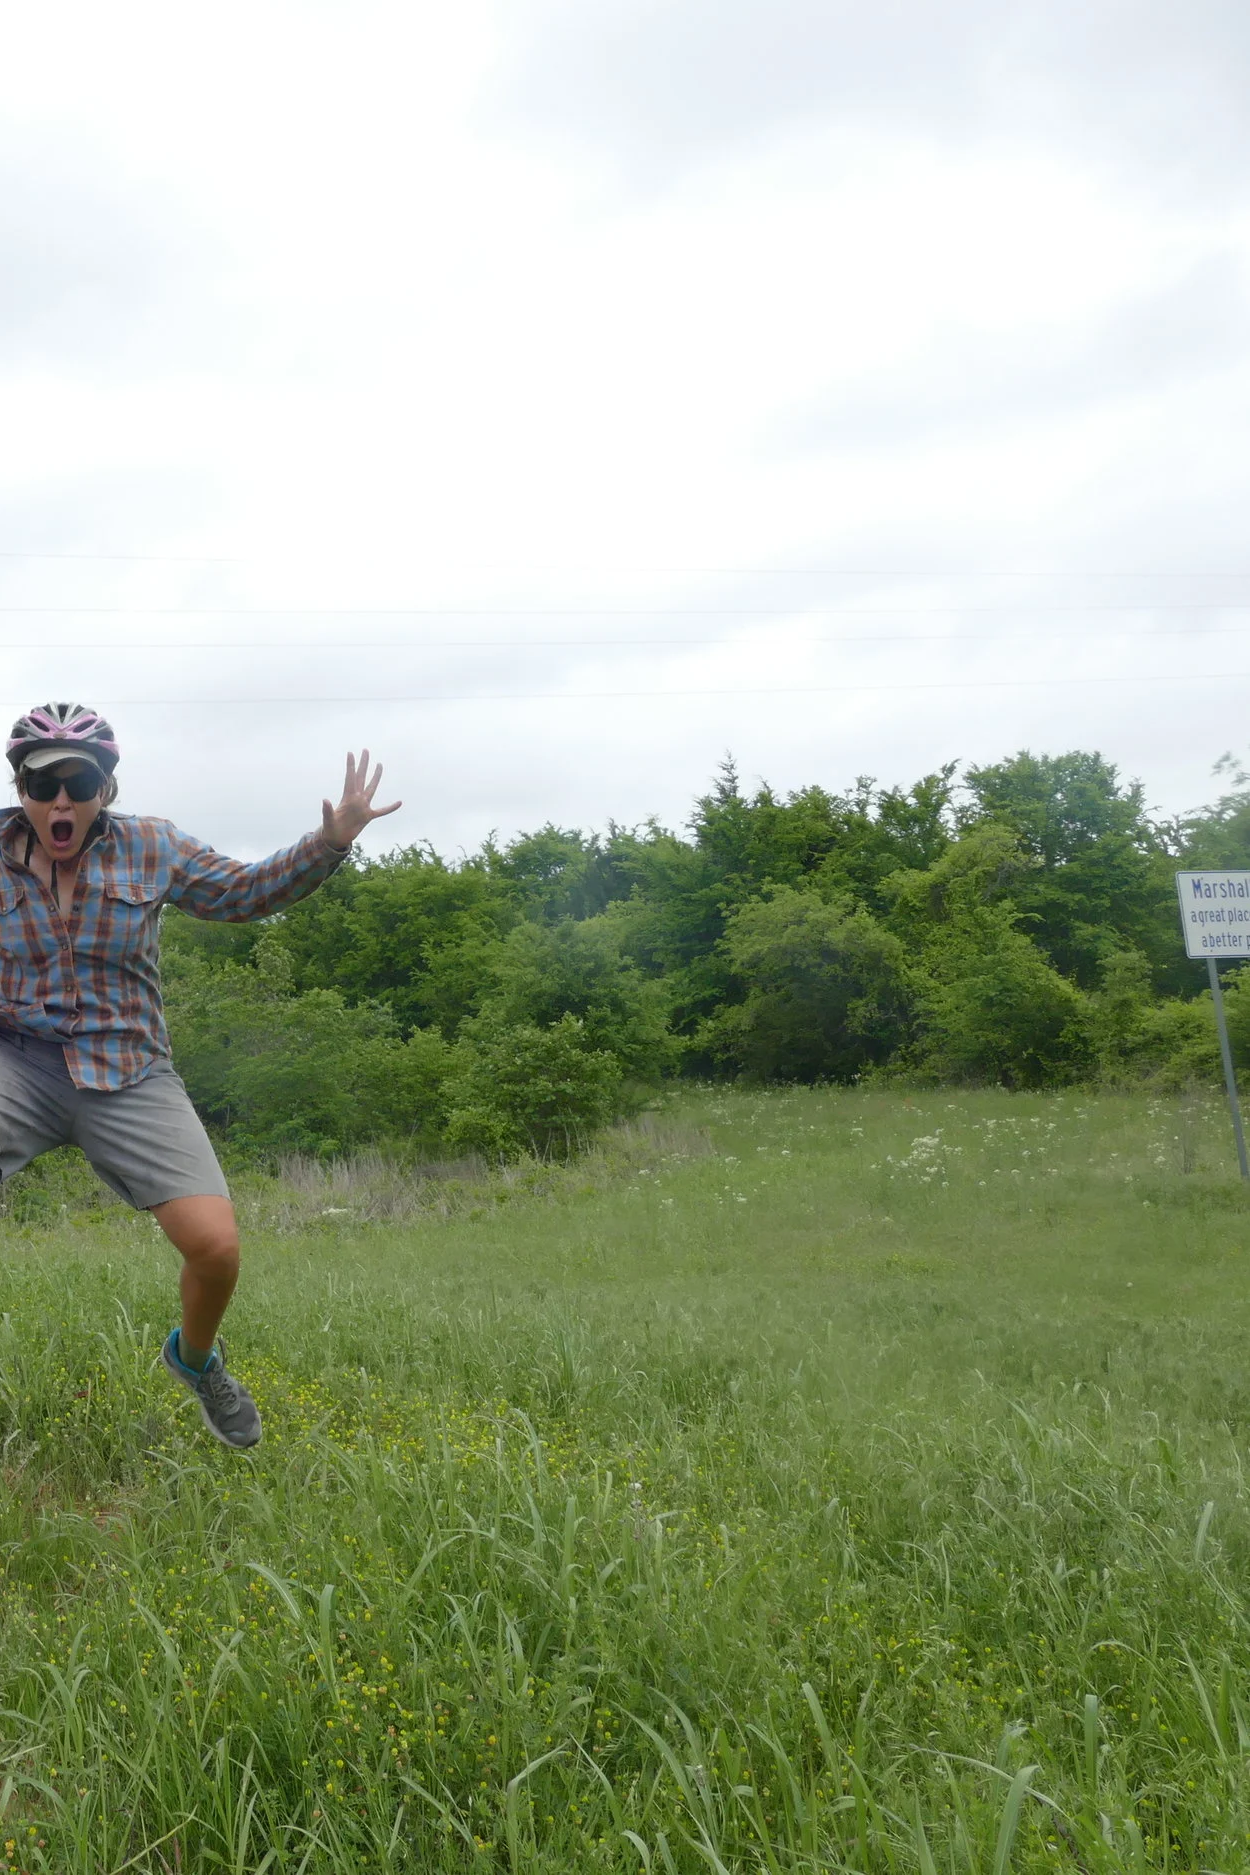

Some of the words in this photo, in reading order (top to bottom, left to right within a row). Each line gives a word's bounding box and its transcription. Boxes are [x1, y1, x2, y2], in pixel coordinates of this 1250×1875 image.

[1191, 878, 1250, 899] Marshal
[1198, 907, 1226, 927] great
[1228, 907, 1250, 925] plac
[1209, 932, 1242, 948] better
